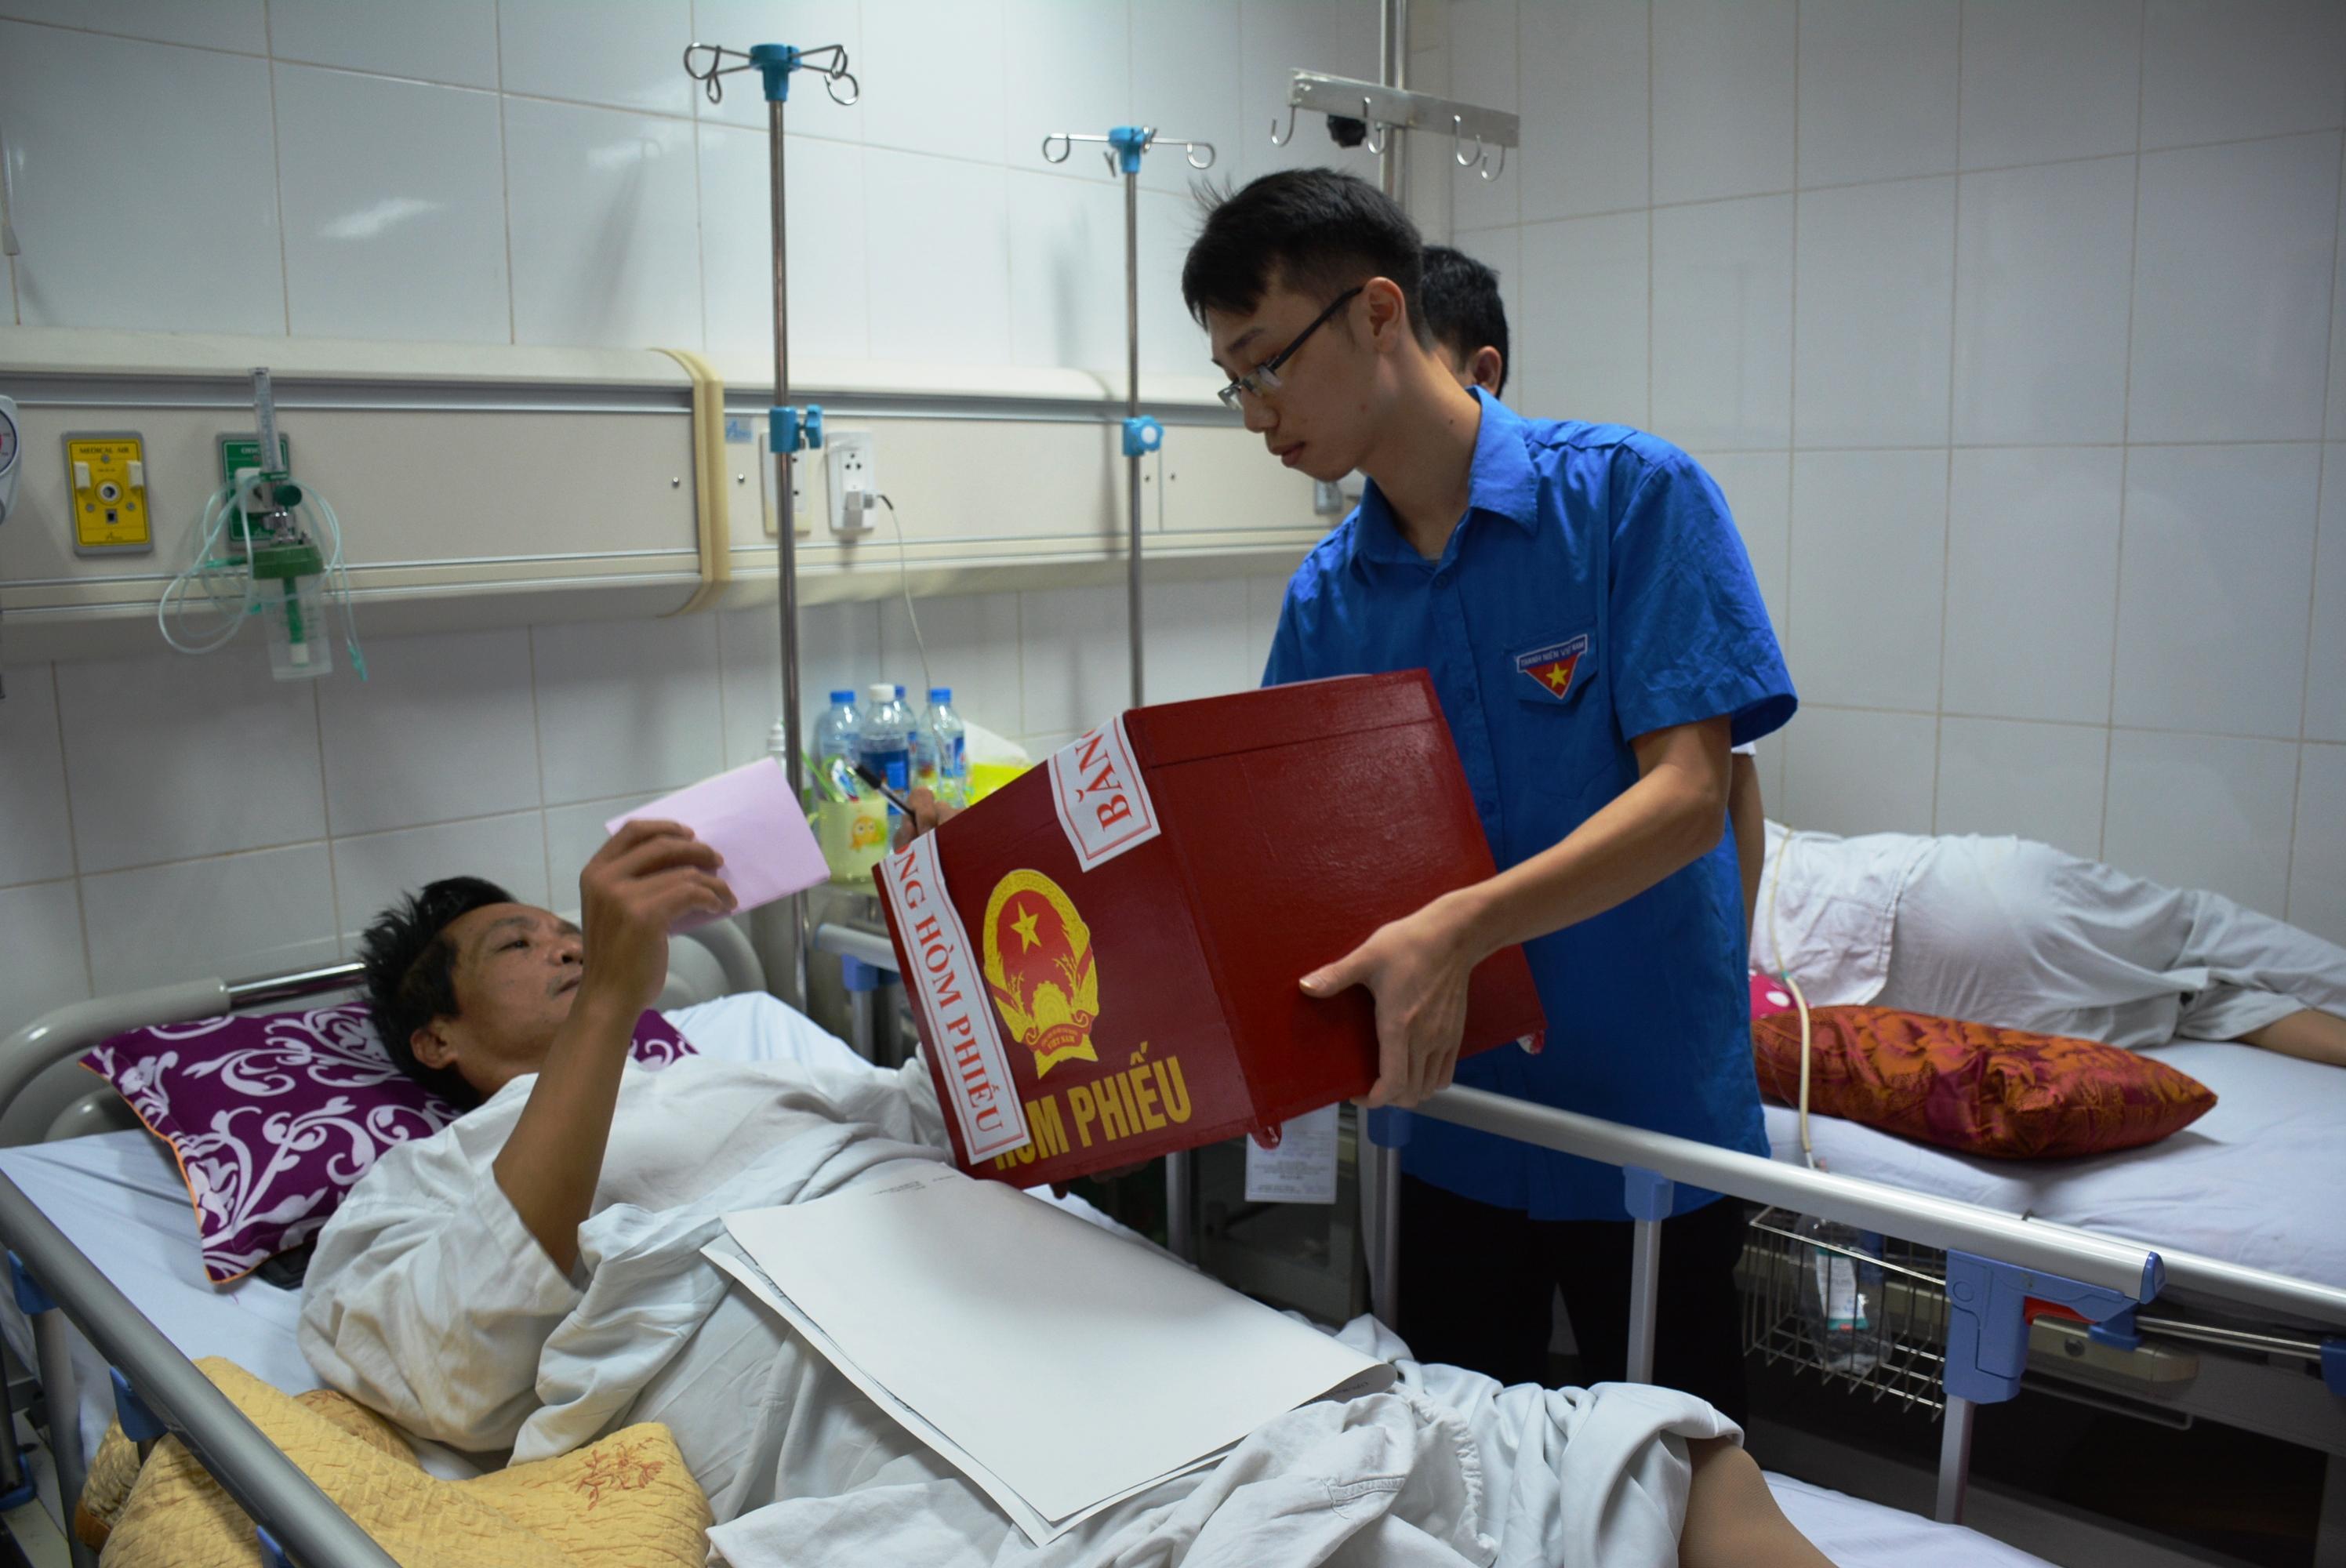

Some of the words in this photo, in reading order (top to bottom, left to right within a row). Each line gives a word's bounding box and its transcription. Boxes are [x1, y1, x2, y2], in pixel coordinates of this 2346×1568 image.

[1075, 729, 1132, 833] BĂN
[913, 912, 964, 1009] HÒM
[946, 1012, 1004, 1133] PHIẾU
[1066, 1040, 1192, 1149] PHIẾU
